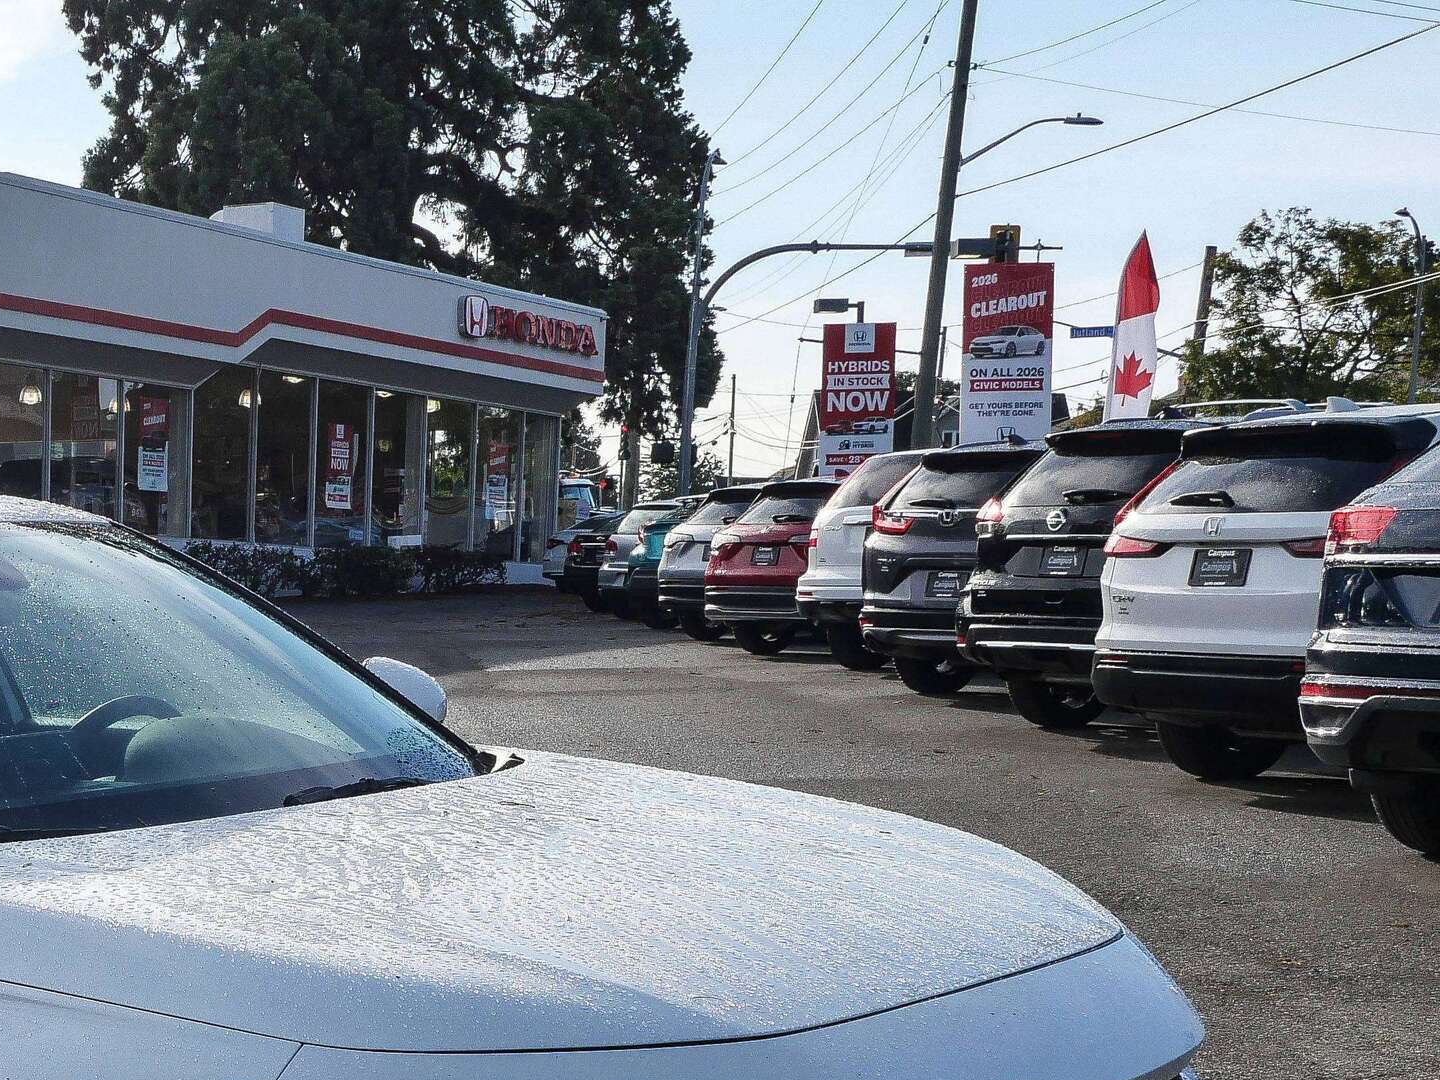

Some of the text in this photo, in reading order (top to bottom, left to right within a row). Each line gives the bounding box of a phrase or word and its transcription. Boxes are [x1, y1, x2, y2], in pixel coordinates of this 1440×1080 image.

[971, 273, 998, 288] 2026
[970, 291, 1047, 318] CLEAROUT
[489, 305, 598, 355] HONDA
[828, 360, 890, 373] HYBRIDS
[970, 367, 1045, 378] ON ALL 2026
[833, 376, 884, 387] IN STOCK
[973, 380, 1041, 390] CIVIC MODELS
[826, 391, 890, 412] NOW
[1014, 401, 1044, 409] BEFORE
[331, 458, 349, 471] NOW
[1208, 549, 1235, 557] Campus
[1201, 562, 1232, 573] Campus
